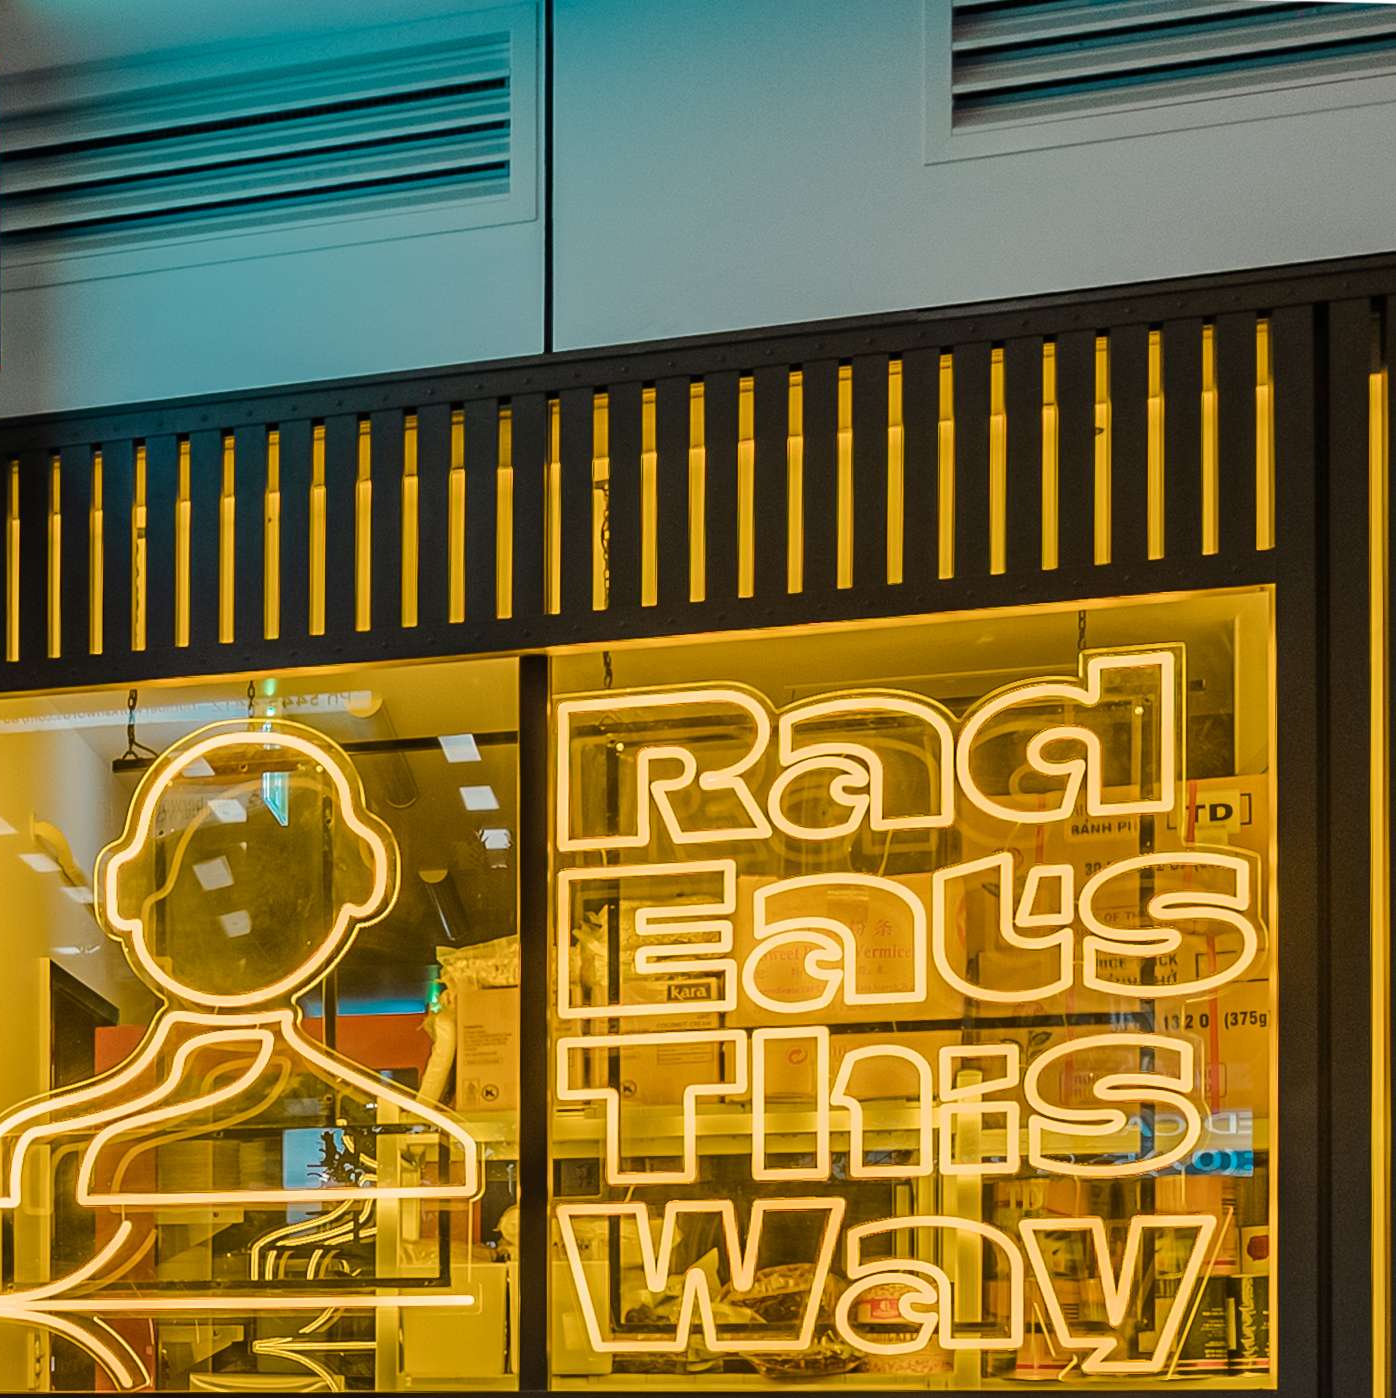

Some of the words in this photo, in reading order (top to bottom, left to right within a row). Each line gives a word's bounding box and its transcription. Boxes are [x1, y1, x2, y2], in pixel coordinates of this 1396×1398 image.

[556, 649, 1176, 853] Rad
[556, 851, 1257, 1019] Eats
[670, 983, 707, 1001] kara
[556, 1025, 1203, 1186] This
[556, 1197, 1217, 1375] Way
